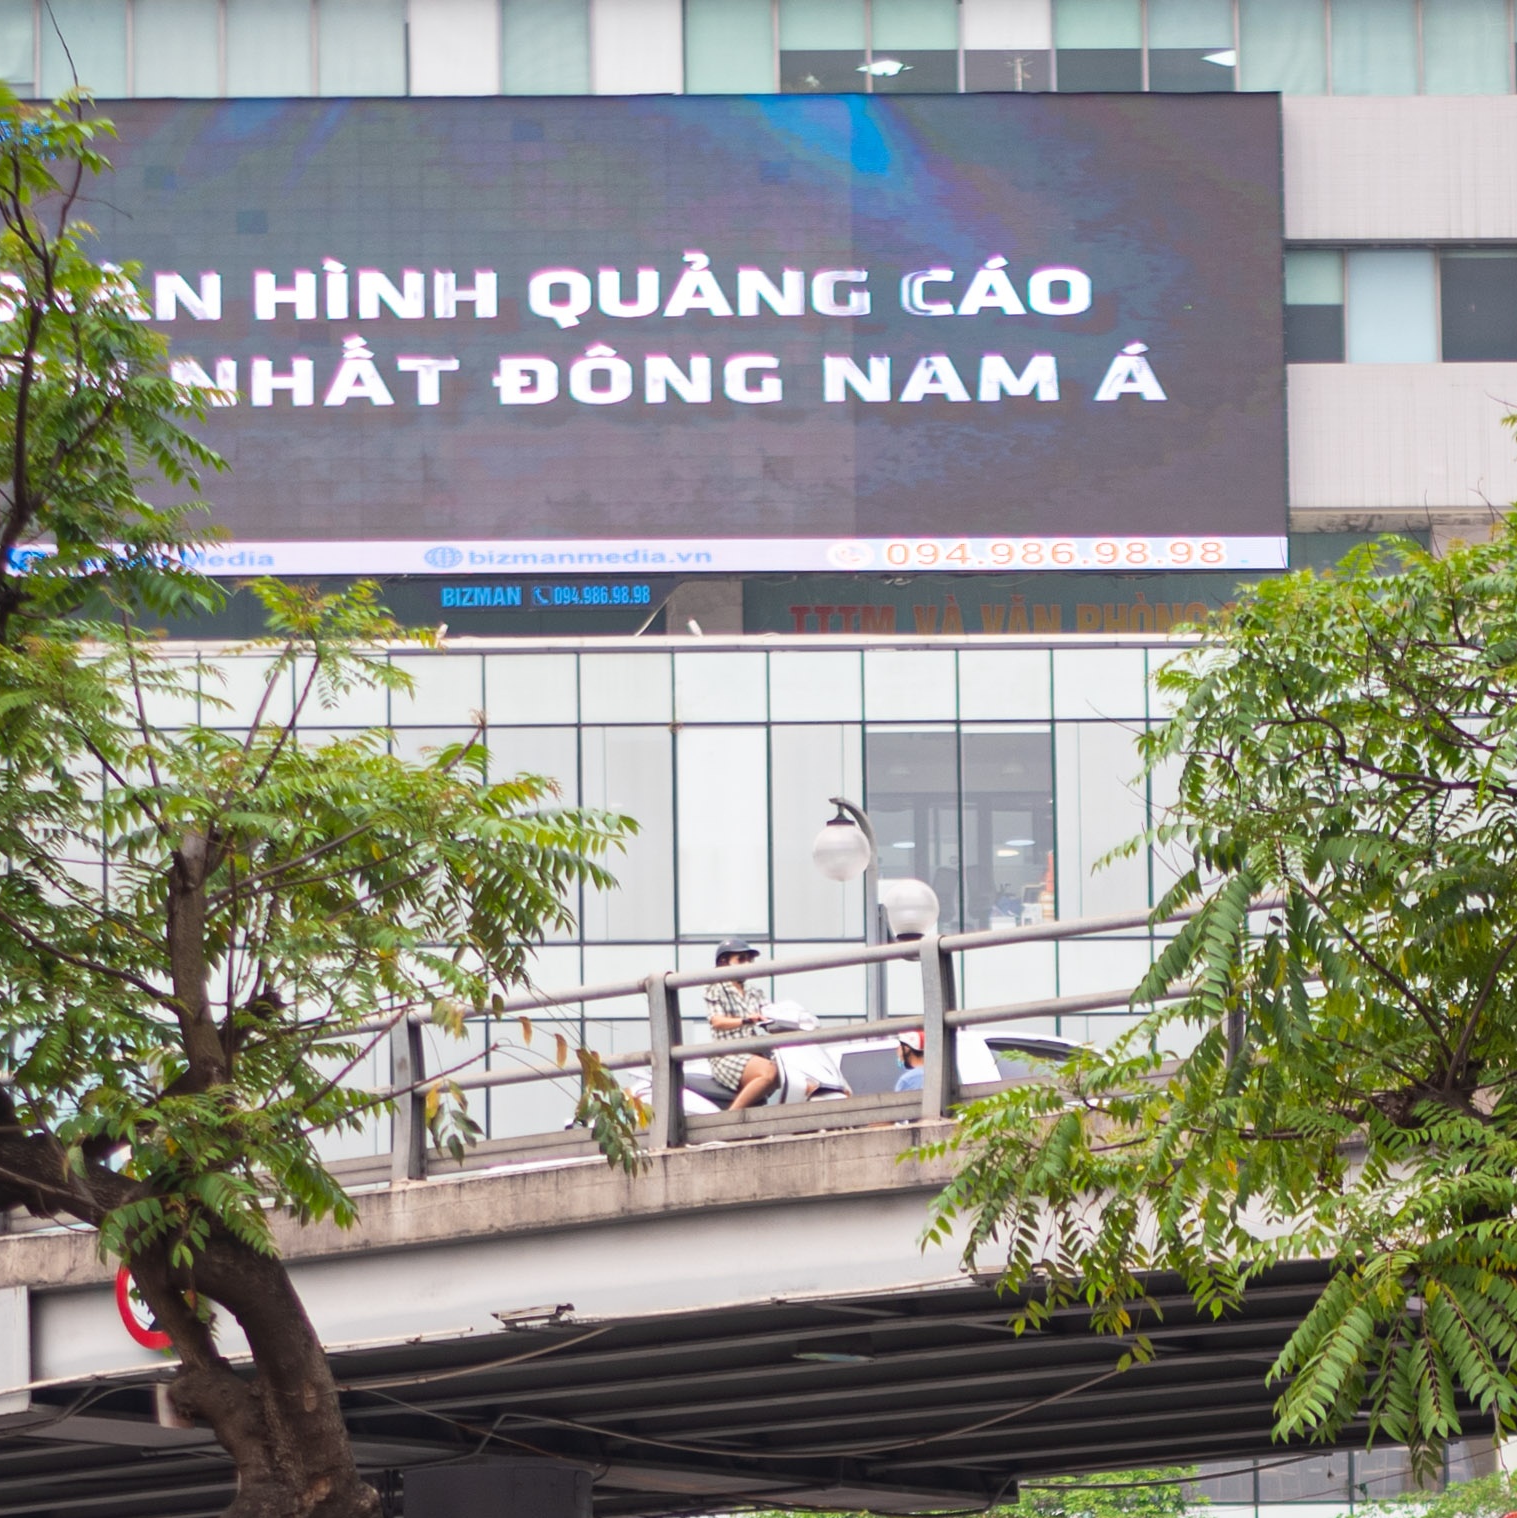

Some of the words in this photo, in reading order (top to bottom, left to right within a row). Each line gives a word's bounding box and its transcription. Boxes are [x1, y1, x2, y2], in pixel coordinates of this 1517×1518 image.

[253, 256, 499, 320] HÌNH
[527, 249, 873, 330] QUẢNG
[899, 254, 1093, 317] CÁO
[169, 333, 460, 408] NHẤT
[491, 342, 784, 406] ĐÔNG
[822, 354, 1062, 404] NAM
[1092, 341, 1169, 403] Á
[467, 548, 714, 566] bizmanmedia.vn
[885, 539, 1228, 567] 094.986.98.98
[440, 585, 522, 608] BIZMAN
[553, 584, 651, 606] 094.986.98.98
